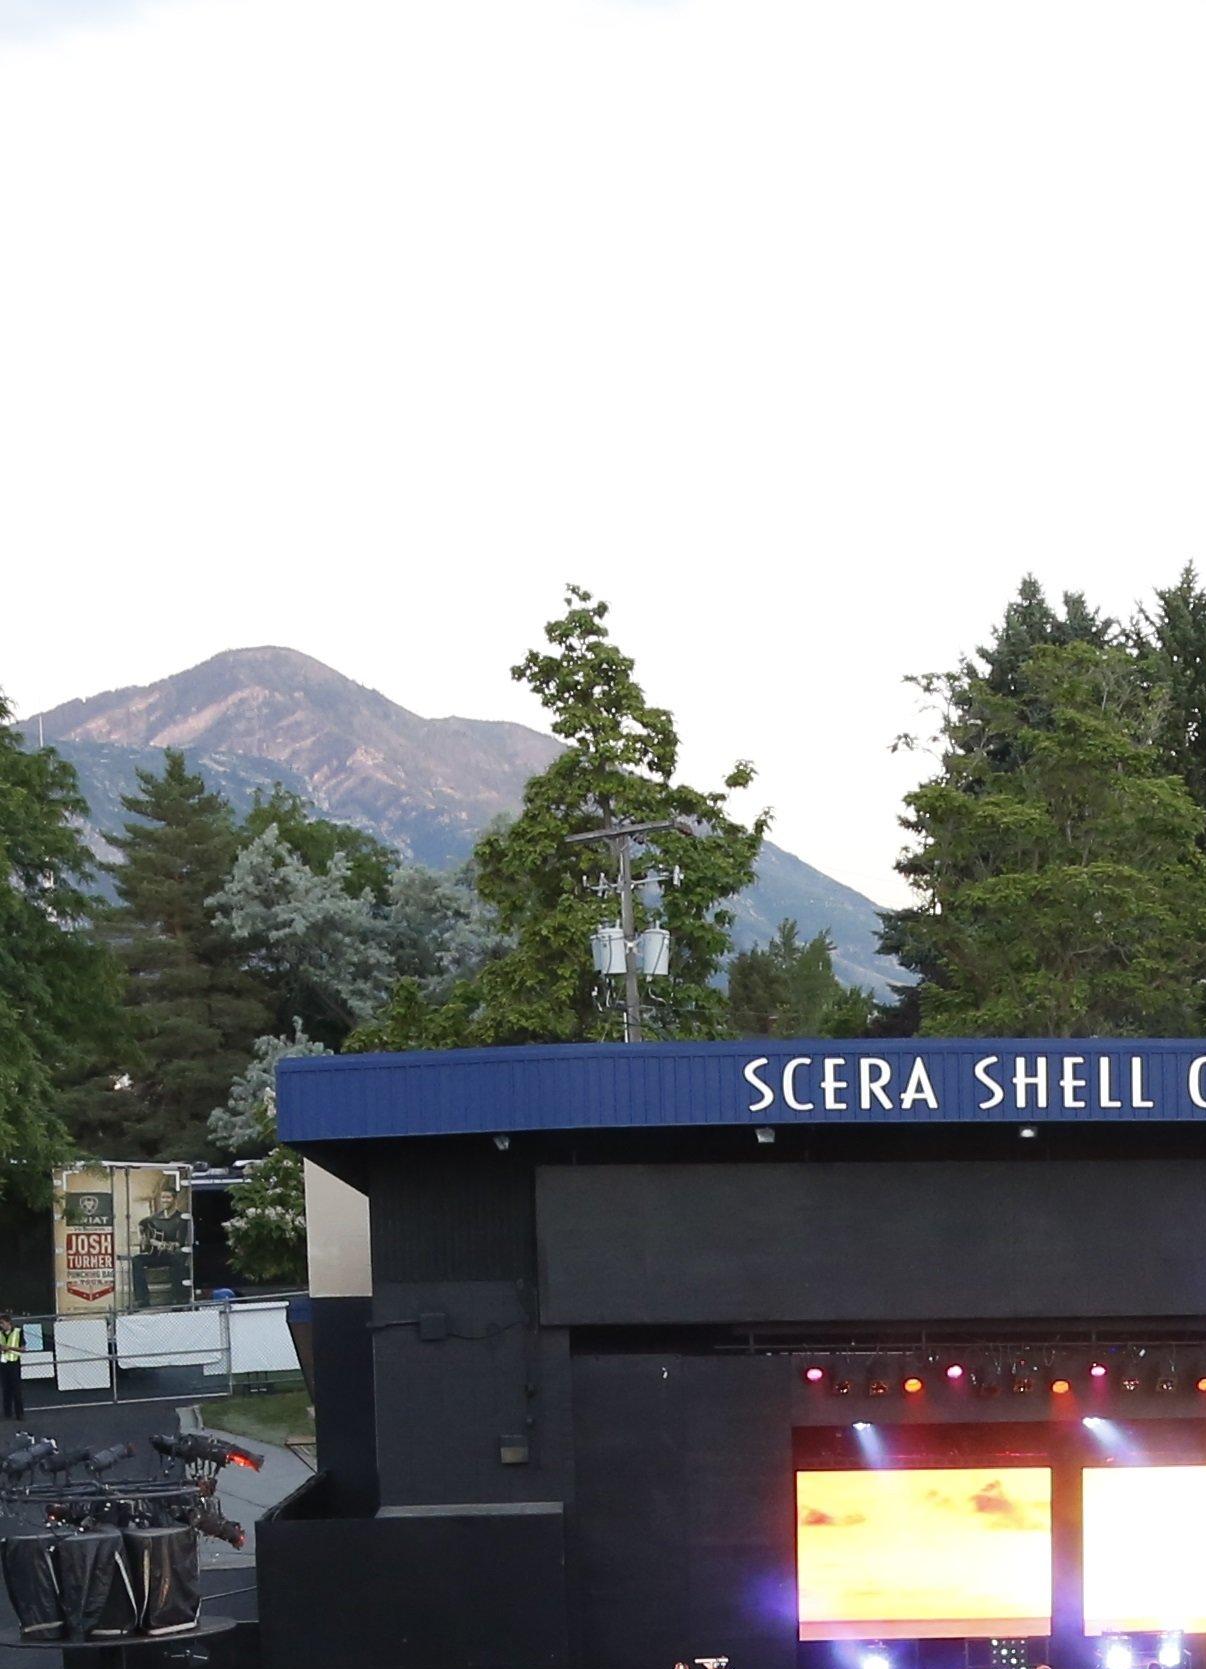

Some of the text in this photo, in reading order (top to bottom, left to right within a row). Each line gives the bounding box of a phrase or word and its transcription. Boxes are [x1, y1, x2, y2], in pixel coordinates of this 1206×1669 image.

[743, 1057, 938, 1112] SCERA
[974, 1056, 1154, 1110] SHELL
[67, 1234, 112, 1255] JOSH
[67, 1255, 113, 1268] TURNER
